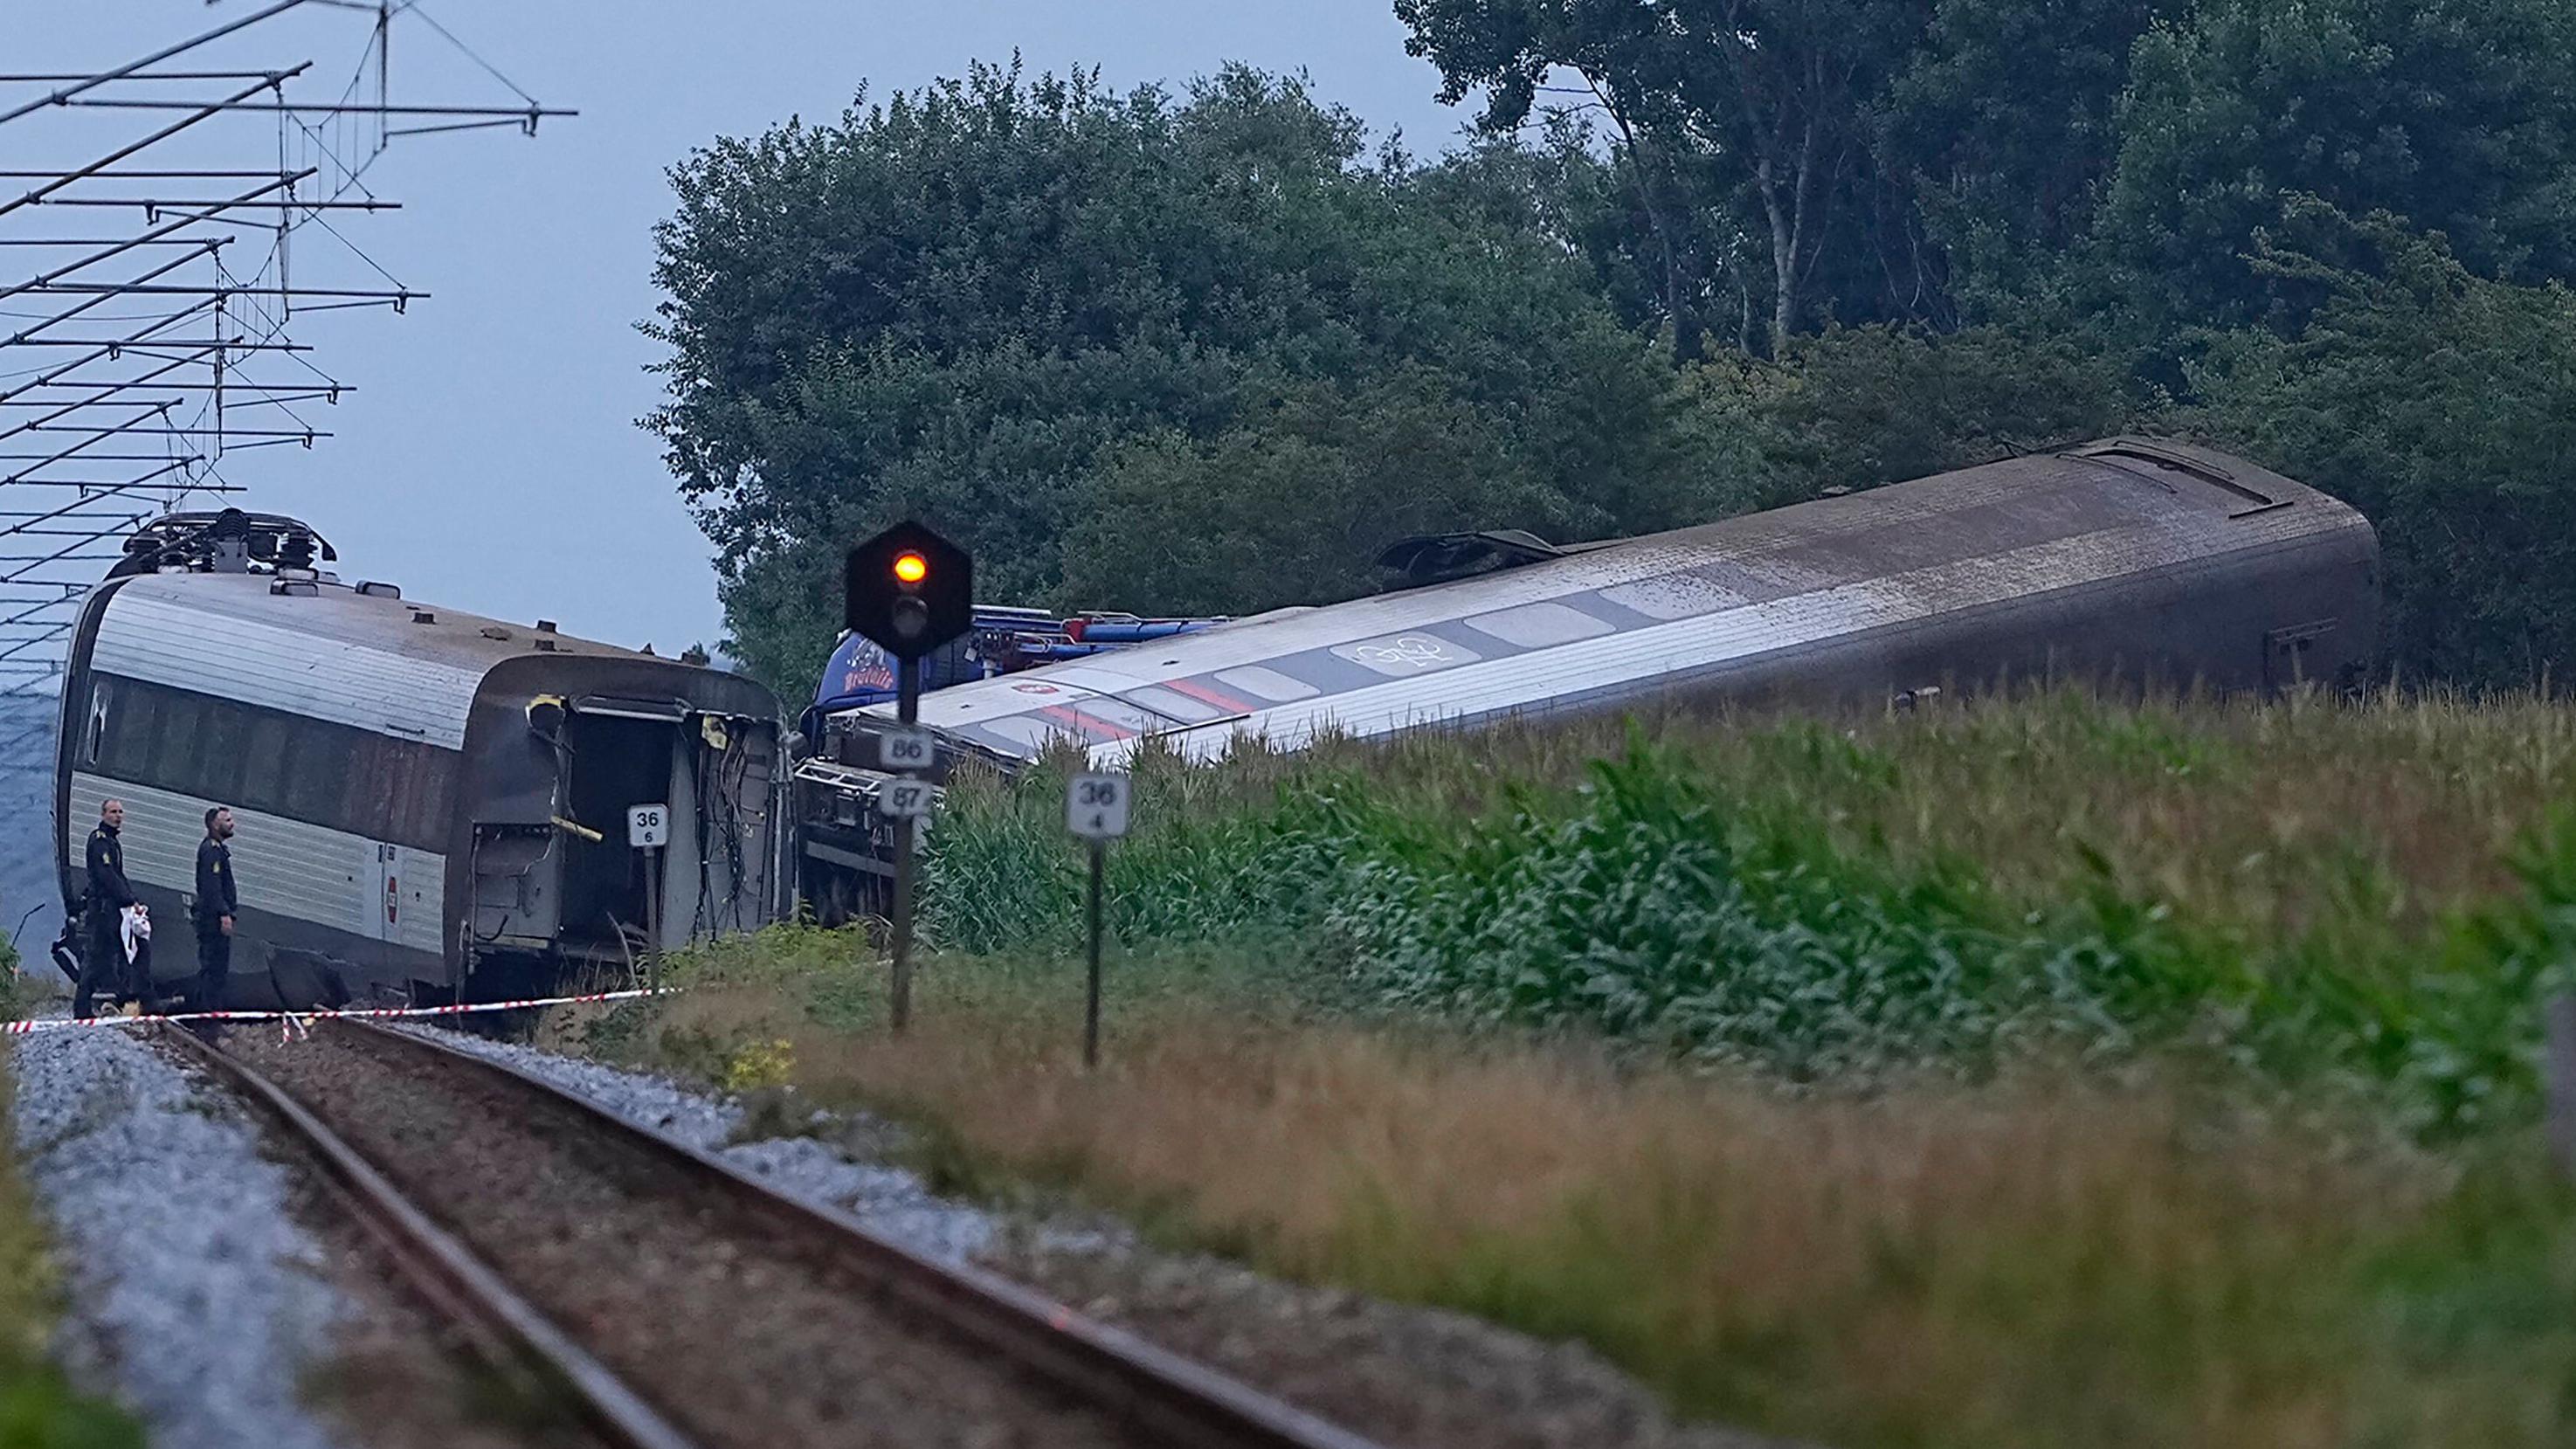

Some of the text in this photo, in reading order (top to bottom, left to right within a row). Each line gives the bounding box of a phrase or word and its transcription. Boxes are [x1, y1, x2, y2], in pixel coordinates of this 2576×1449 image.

[892, 738, 922, 759] 86
[893, 786, 922, 807] 87
[1079, 781, 1117, 806] 36
[637, 811, 659, 827] 36
[645, 831, 653, 843] 6
